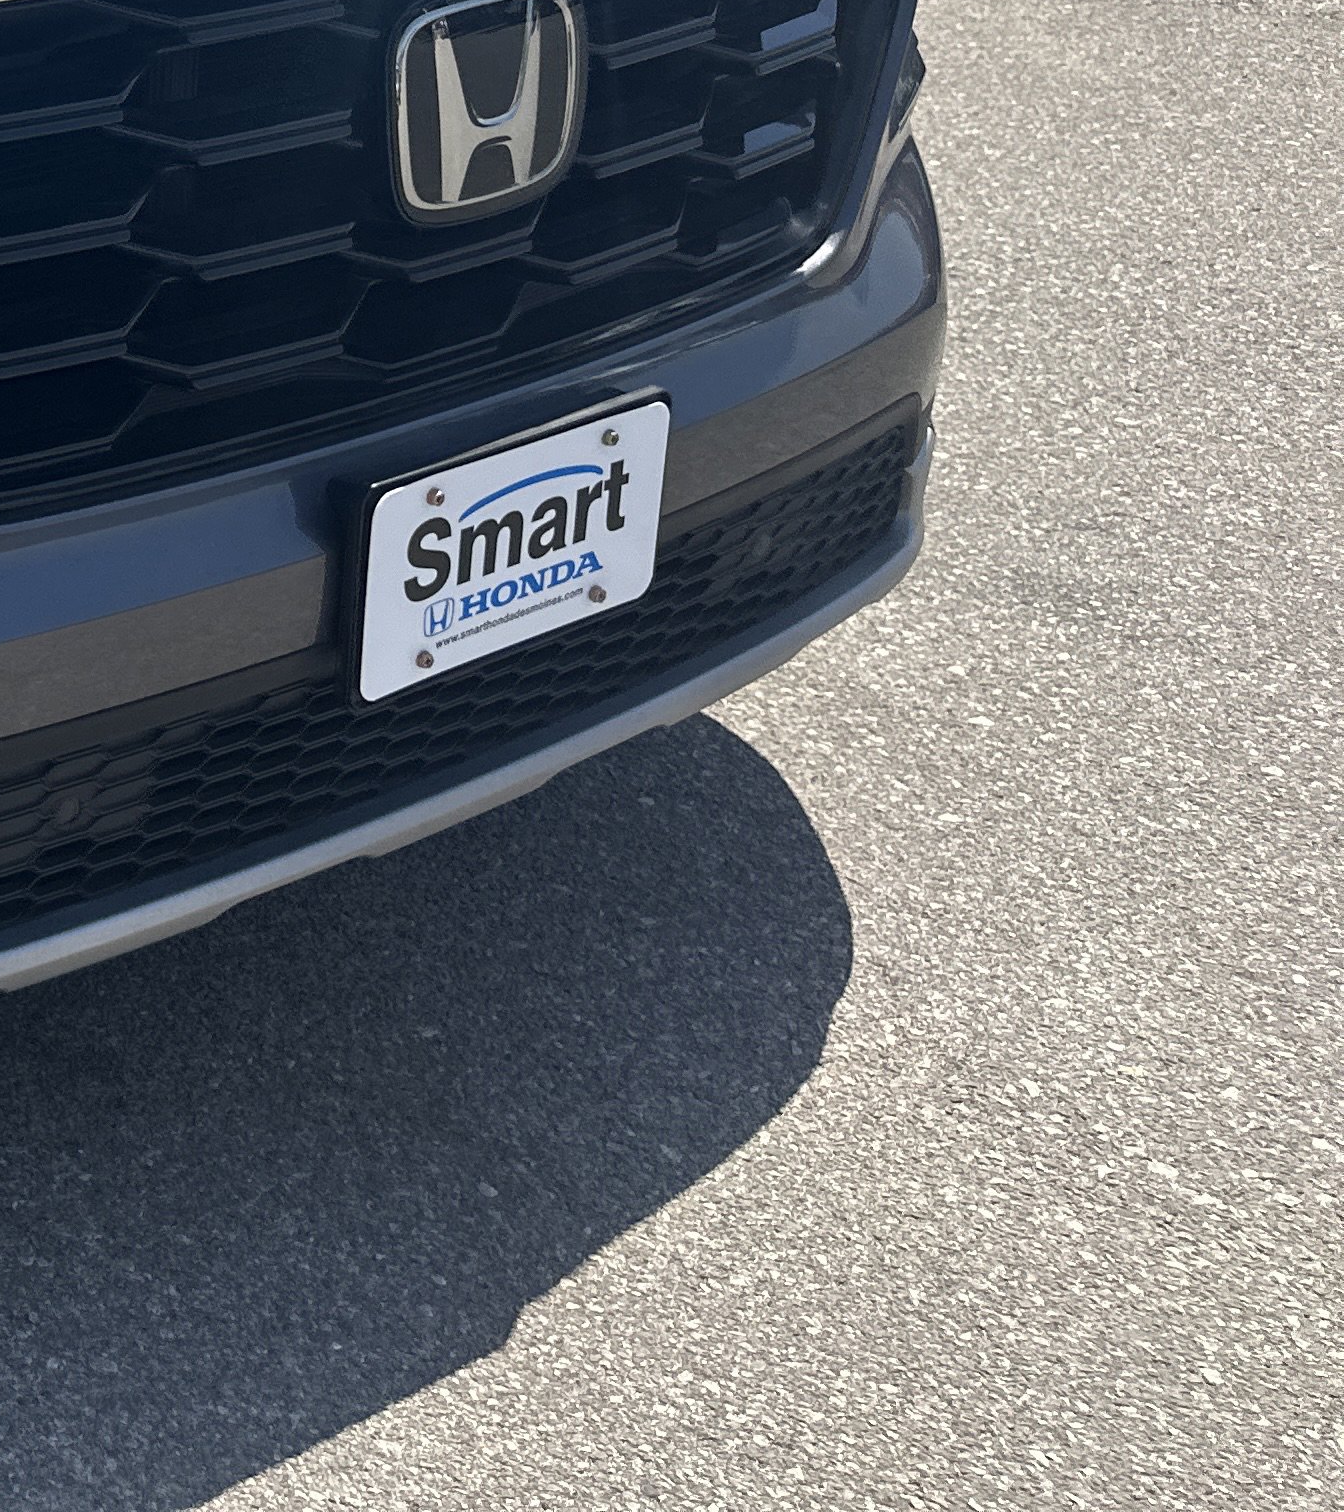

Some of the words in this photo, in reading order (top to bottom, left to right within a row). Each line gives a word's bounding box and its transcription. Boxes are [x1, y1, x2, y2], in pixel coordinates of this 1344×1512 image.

[404, 460, 629, 602] Smart
[435, 587, 584, 649] www.smarthondadesmoines.com
[459, 551, 603, 620] HONDA
